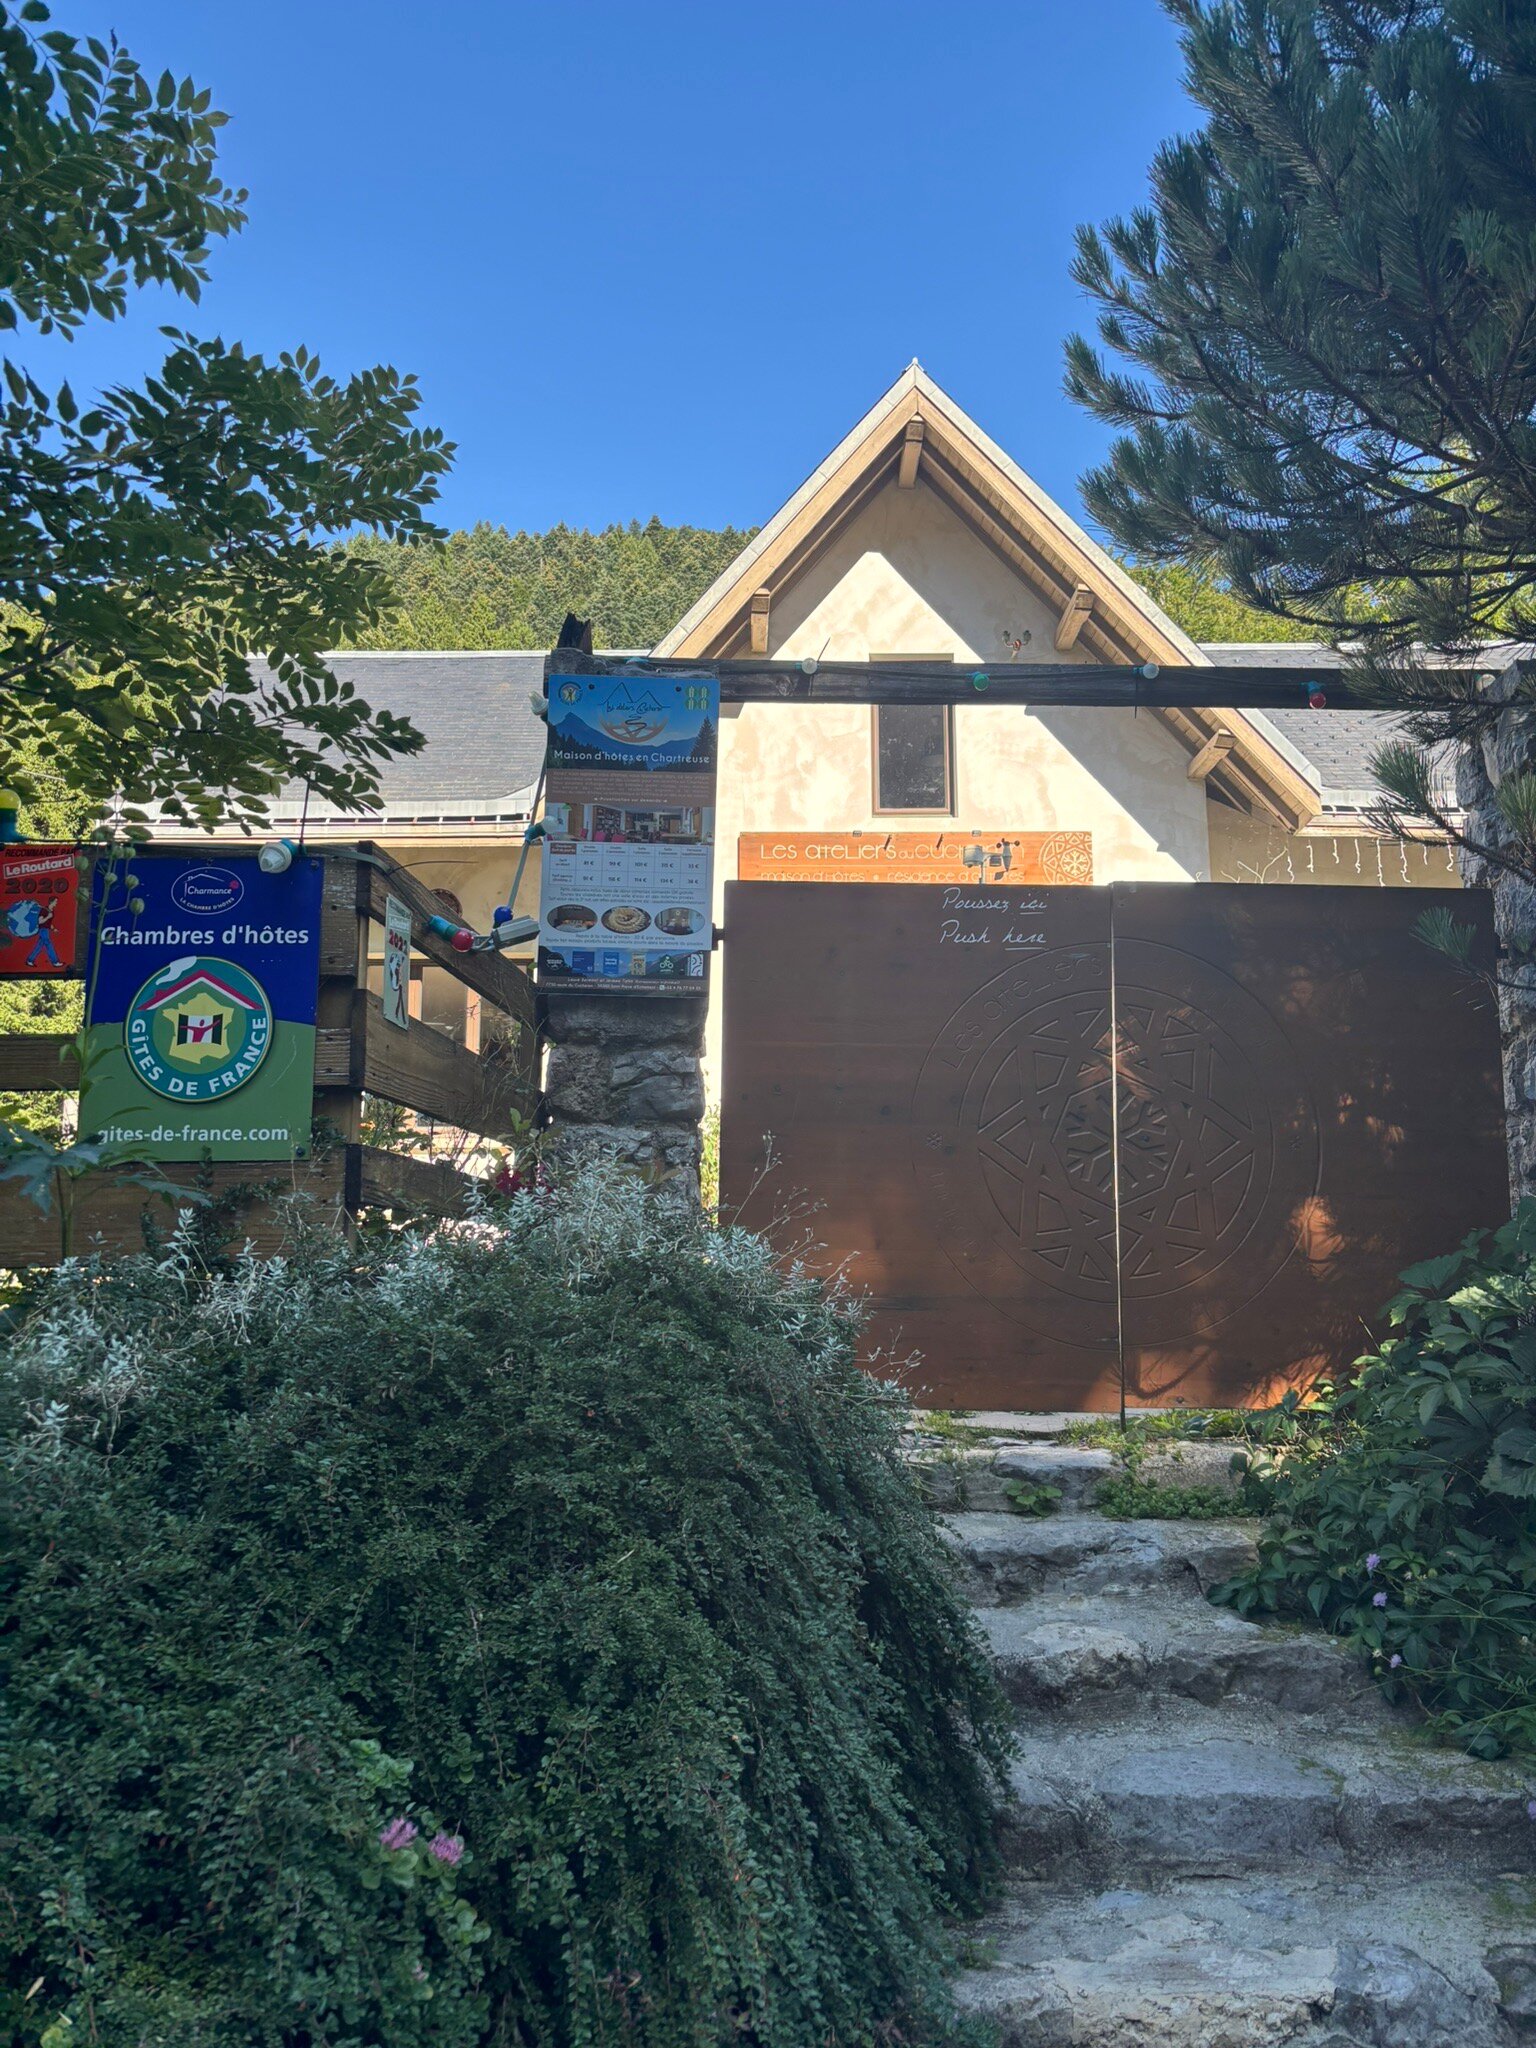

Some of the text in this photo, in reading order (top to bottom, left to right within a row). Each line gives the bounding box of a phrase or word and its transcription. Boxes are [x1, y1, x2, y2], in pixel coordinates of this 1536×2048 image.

[553, 750, 710, 763] Maison d'hôtes en Chartreuse
[5, 877, 69, 894] 2020
[187, 886, 232, 895] Charmance
[943, 887, 1047, 913] Poussez ici
[101, 924, 309, 945] Chambres d'hôtes
[940, 919, 1047, 944] Push here
[168, 1077, 198, 1096] DE
[208, 1017, 267, 1094] FRANCE
[98, 1124, 289, 1145] gites-de-france.com
